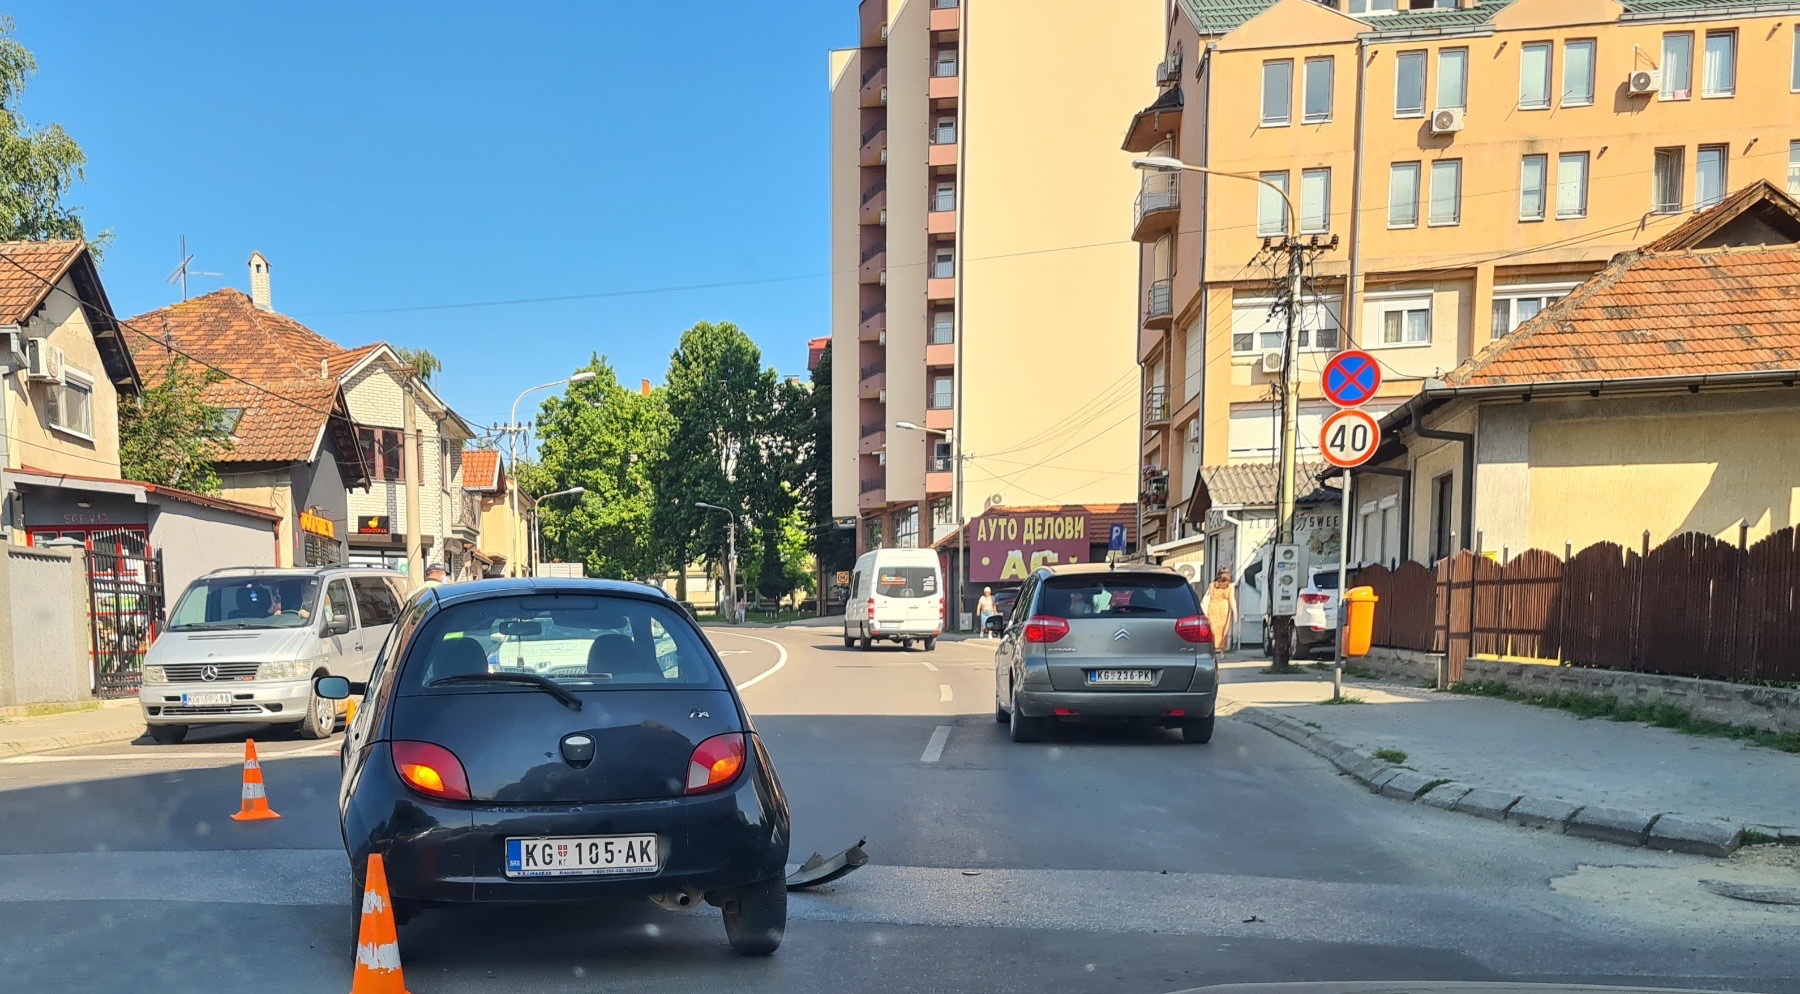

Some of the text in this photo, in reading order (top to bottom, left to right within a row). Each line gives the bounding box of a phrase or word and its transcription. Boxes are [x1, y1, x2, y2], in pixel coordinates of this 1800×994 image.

[1329, 424, 1367, 452] 40
[977, 515, 1085, 545] АУТО ДЕЛОВИ
[1309, 515, 1339, 527] SWEE
[1112, 526, 1120, 540] P
[1097, 670, 1110, 680] KG
[525, 843, 553, 867] KG
